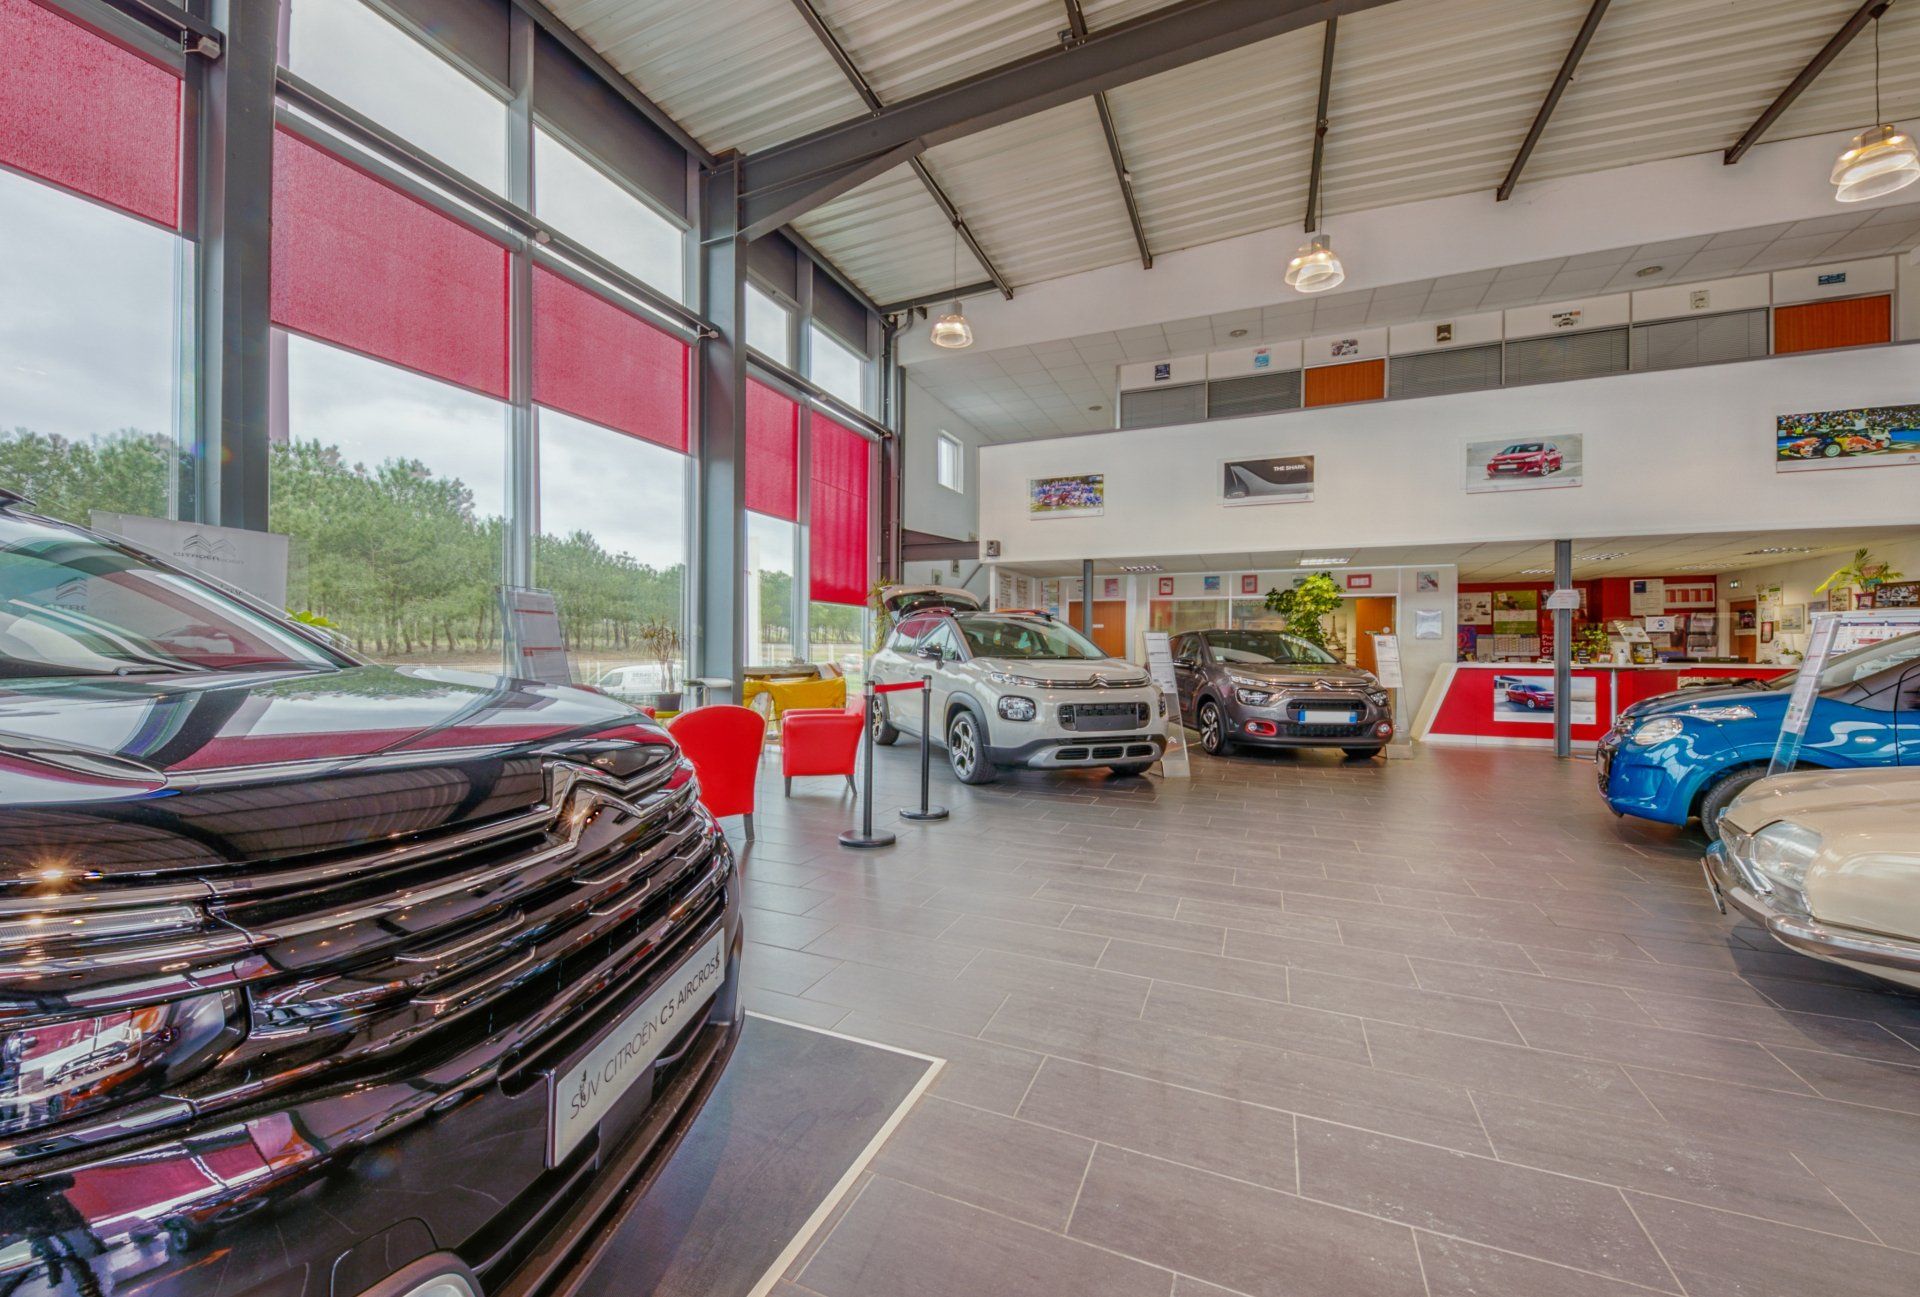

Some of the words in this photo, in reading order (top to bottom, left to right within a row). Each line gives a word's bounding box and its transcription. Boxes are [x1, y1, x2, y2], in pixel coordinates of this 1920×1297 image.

[1286, 463, 1306, 471] SHARK
[570, 1071, 601, 1119] SUV
[604, 1016, 658, 1083] CITROËN
[660, 998, 675, 1025] C5
[677, 951, 721, 1010] AIRCROSS
